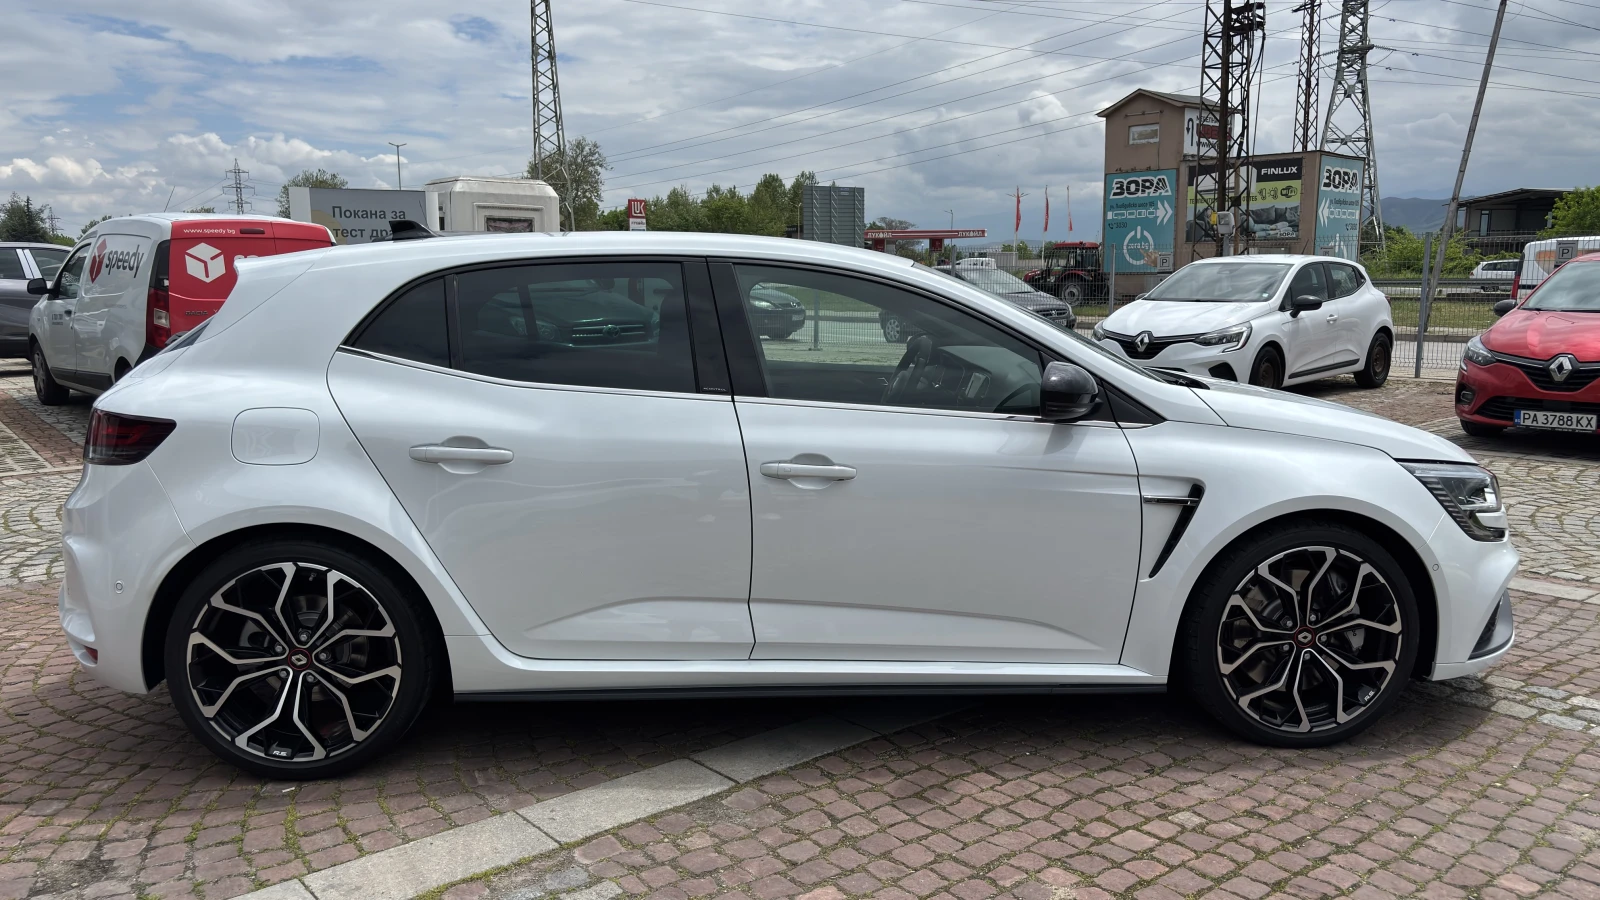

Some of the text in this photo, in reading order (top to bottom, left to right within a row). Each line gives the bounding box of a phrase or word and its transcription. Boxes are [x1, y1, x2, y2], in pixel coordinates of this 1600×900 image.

[1261, 166, 1298, 176] FINLUX
[1321, 166, 1360, 193] ЗОРА
[1110, 175, 1172, 199] ЗОРА
[332, 206, 406, 220] Покана за
[333, 228, 366, 238] тест
[1561, 248, 1570, 257] P
[105, 244, 145, 279] speedy
[1161, 258, 1168, 266] P
[1522, 412, 1594, 428] PA 3788 KX
